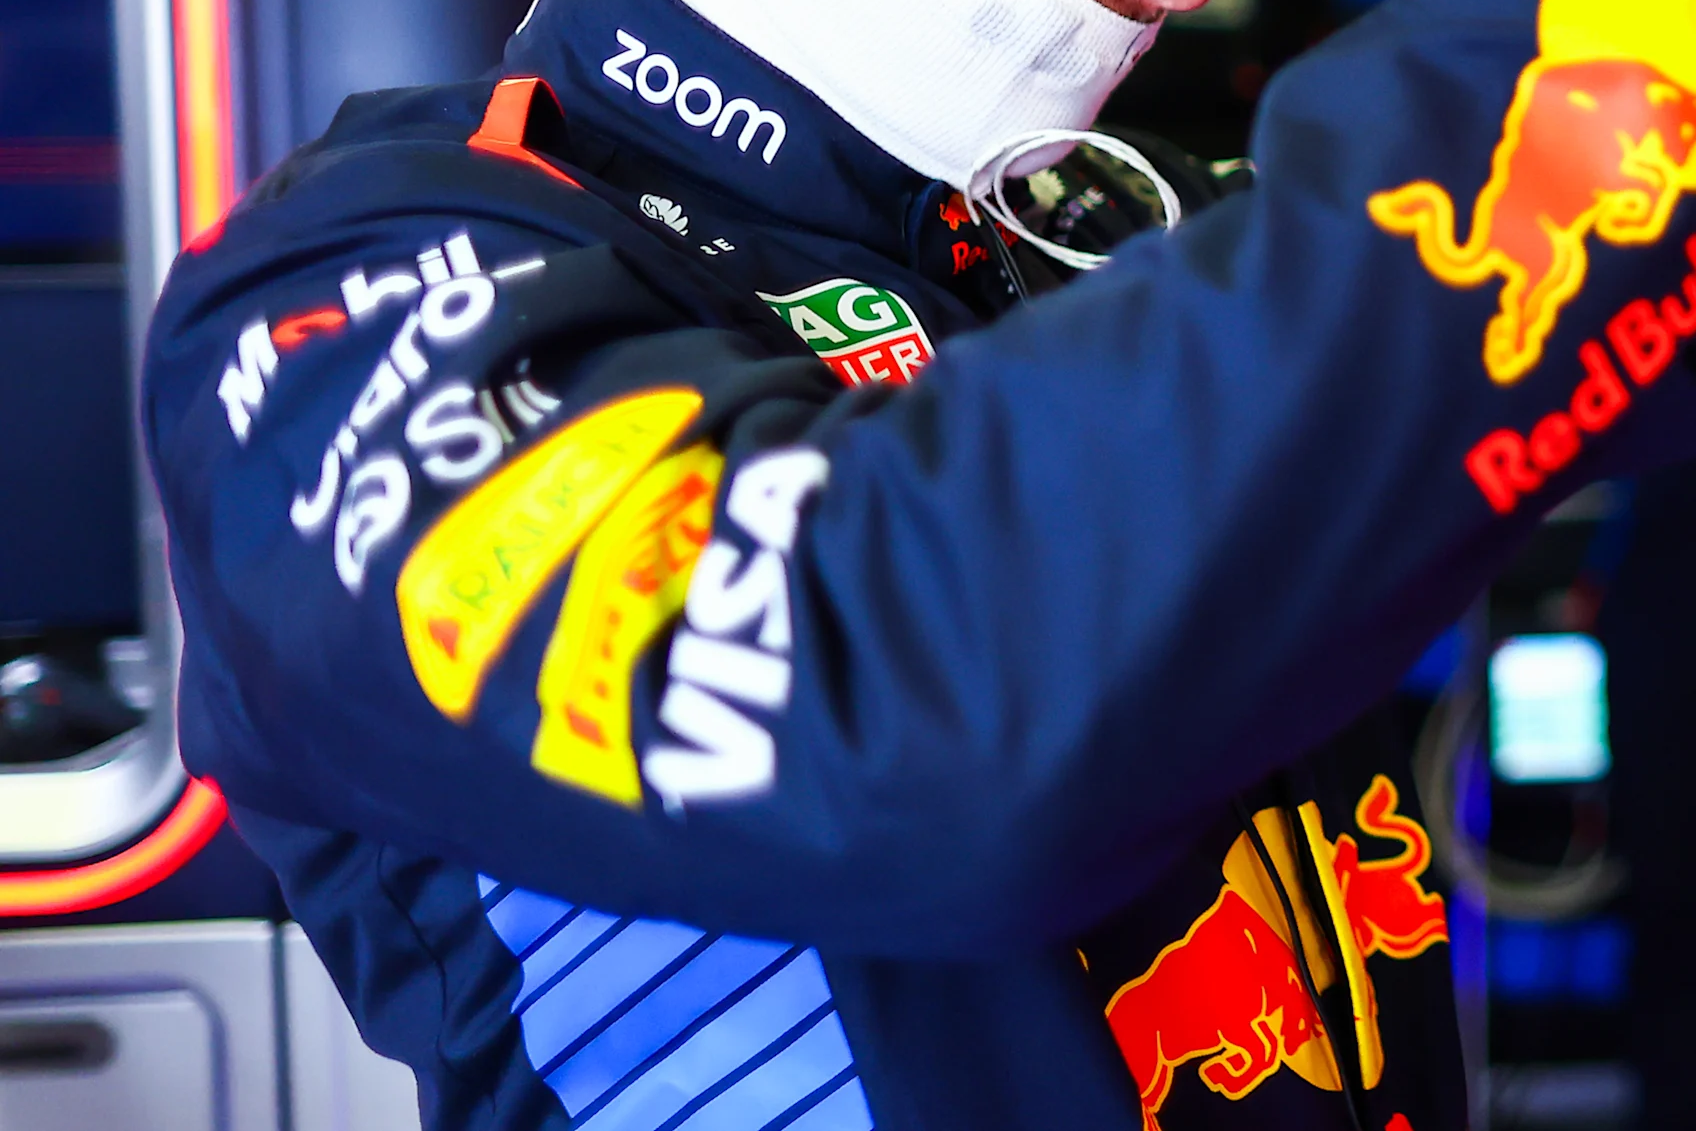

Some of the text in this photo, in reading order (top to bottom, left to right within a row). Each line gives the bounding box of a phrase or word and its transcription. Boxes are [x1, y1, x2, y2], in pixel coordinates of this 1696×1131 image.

[602, 27, 788, 166] zoom
[770, 286, 899, 345] AG
[1463, 338, 1630, 514] Red
[642, 447, 831, 810] VISA
